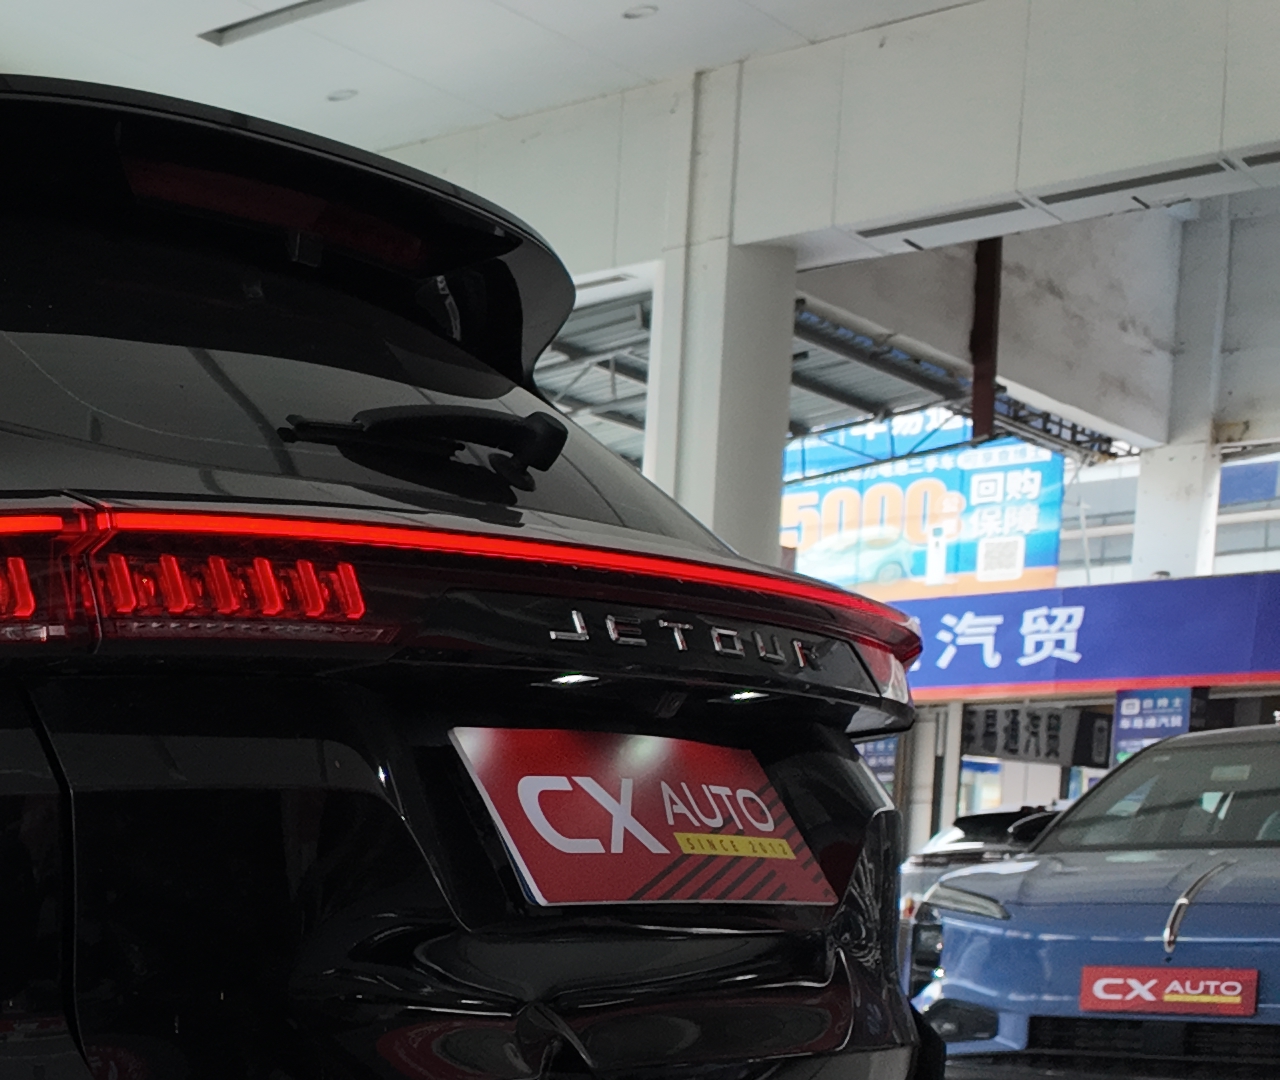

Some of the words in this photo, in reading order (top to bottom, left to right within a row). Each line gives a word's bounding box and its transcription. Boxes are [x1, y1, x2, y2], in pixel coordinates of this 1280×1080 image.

[970, 468, 1042, 506] 回购
[549, 610, 823, 671] JETOUR
[517, 775, 671, 854] CX
[661, 780, 775, 832] AUTO
[686, 837, 739, 853] SINCE
[749, 840, 789, 857] 2012
[1092, 977, 1159, 1002] CX
[1164, 979, 1243, 996] AUTO
